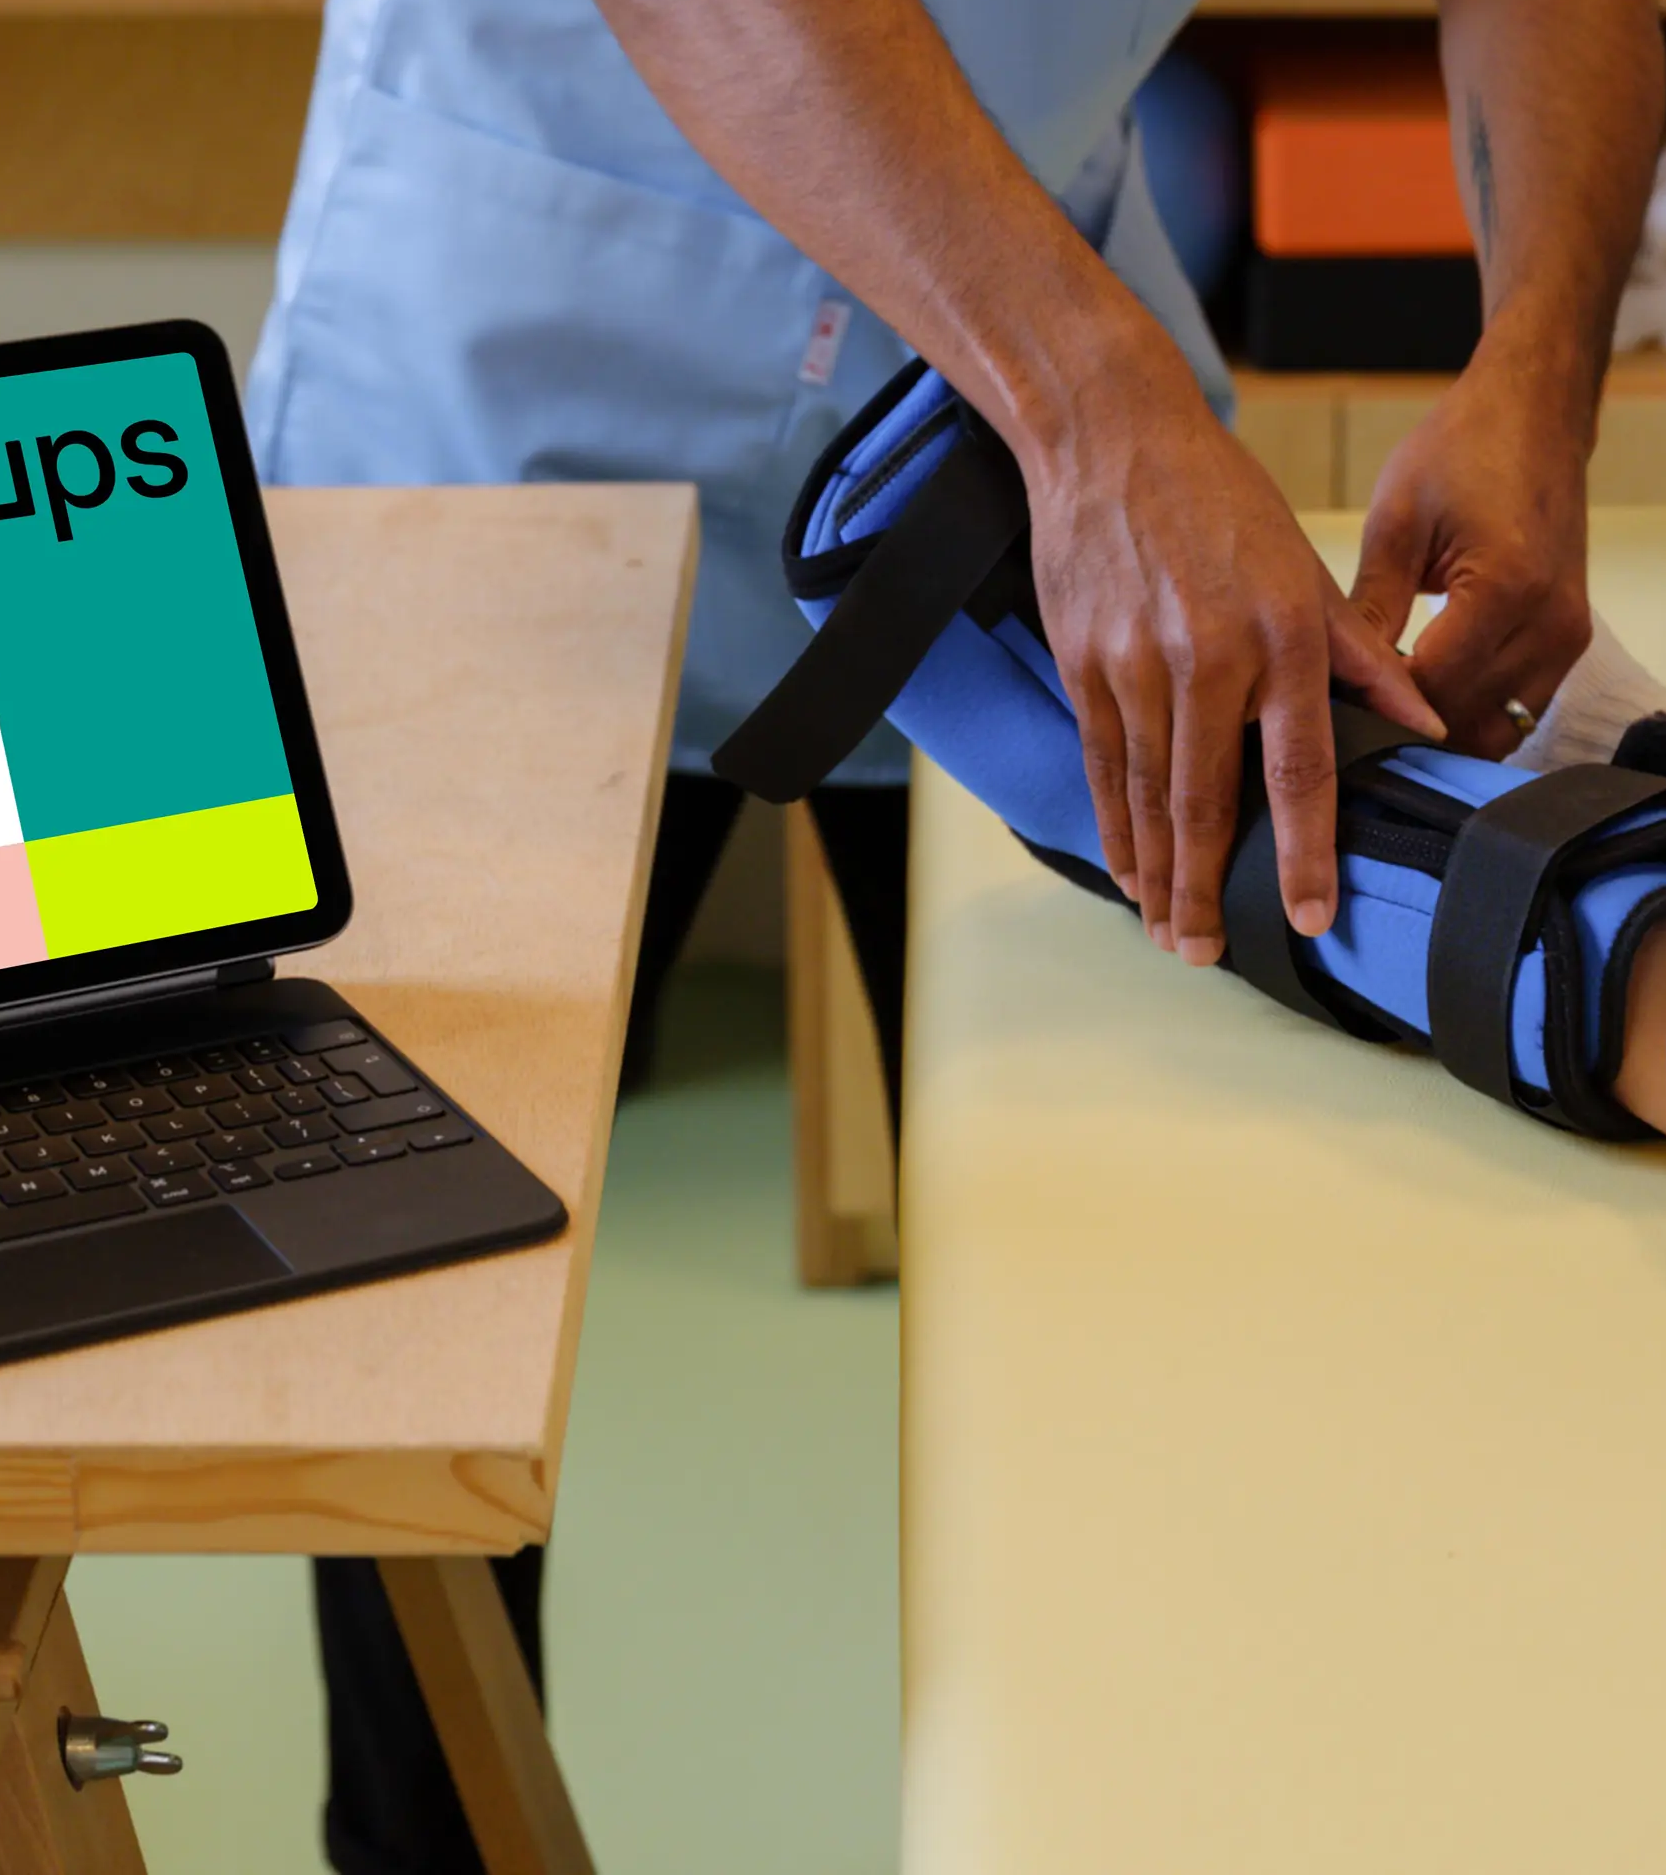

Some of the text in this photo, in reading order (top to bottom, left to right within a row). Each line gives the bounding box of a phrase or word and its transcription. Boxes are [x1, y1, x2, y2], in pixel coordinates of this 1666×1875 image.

[128, 1097, 144, 1107] O
[194, 1085, 208, 1094] P
[37, 1147, 47, 1157] J
[100, 1133, 116, 1143] K
[169, 1121, 183, 1130] L
[20, 1181, 37, 1192] N
[88, 1165, 108, 1177] M
